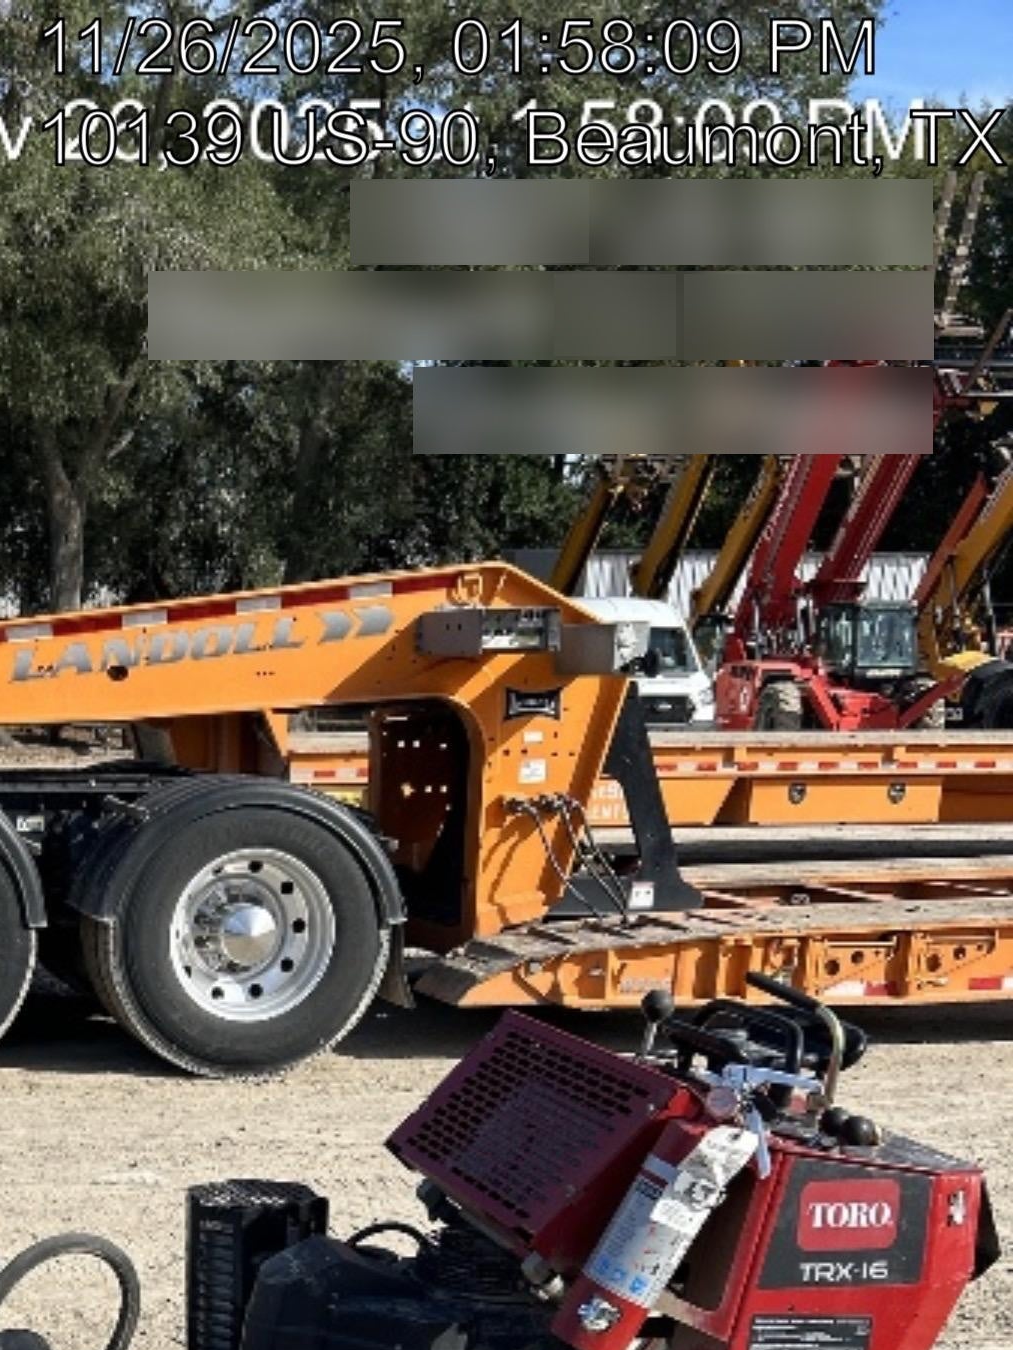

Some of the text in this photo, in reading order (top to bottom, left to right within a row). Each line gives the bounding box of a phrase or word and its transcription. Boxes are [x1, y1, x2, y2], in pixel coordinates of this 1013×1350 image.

[10, 617, 306, 683] LANDOLL
[808, 1201, 892, 1229] TORO
[798, 1260, 889, 1282] TRX-16
